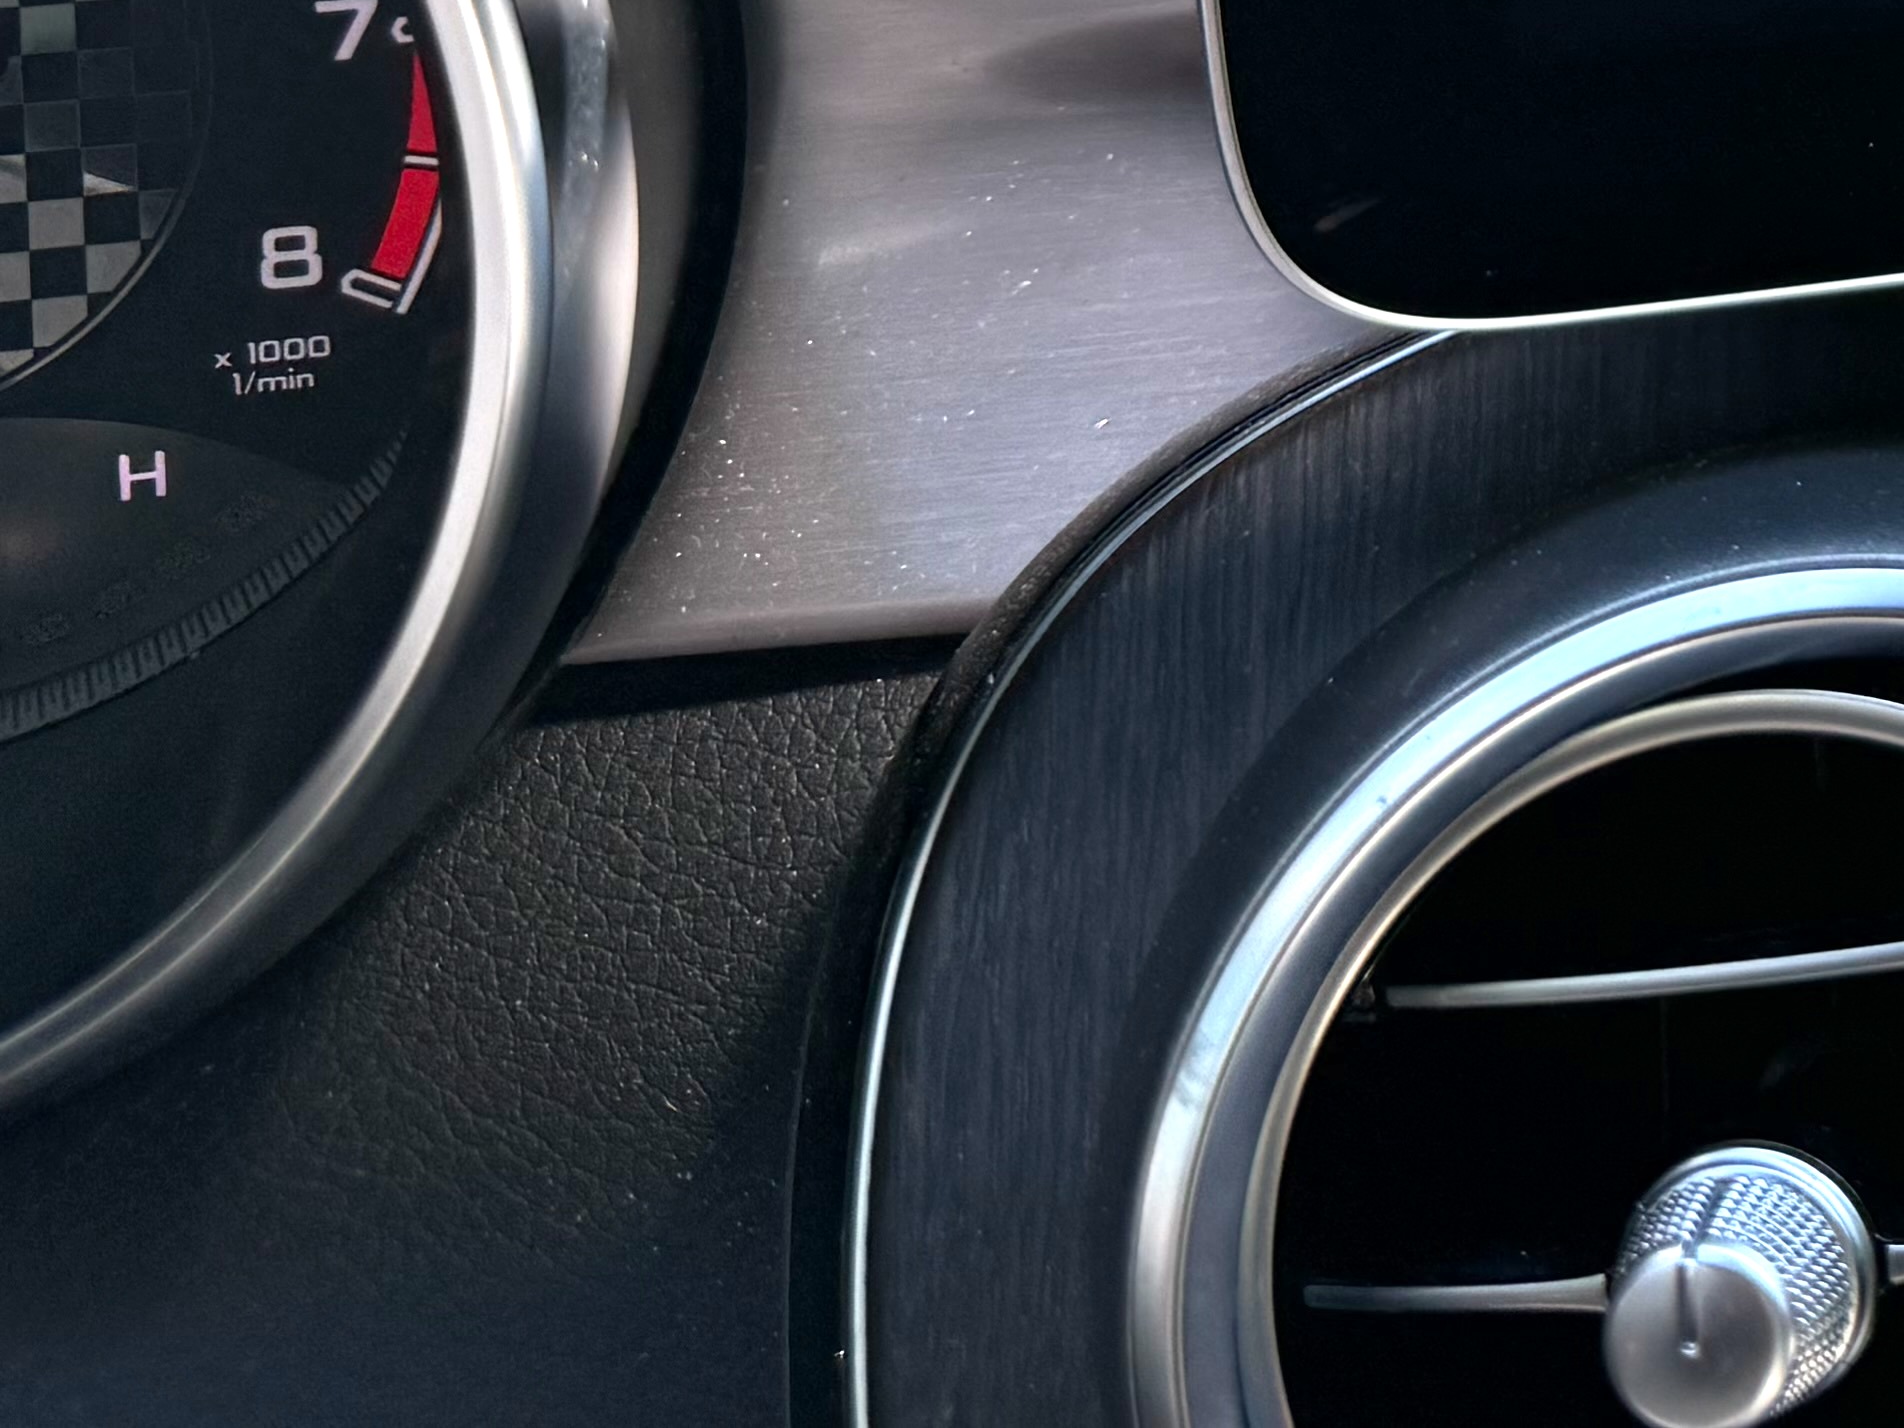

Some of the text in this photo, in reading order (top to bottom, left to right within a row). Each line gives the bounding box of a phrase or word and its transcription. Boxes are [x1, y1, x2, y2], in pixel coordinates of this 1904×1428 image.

[259, 225, 324, 290] 8
[247, 334, 332, 365] 1000
[231, 367, 316, 396] 1/min
[117, 449, 168, 502] H
